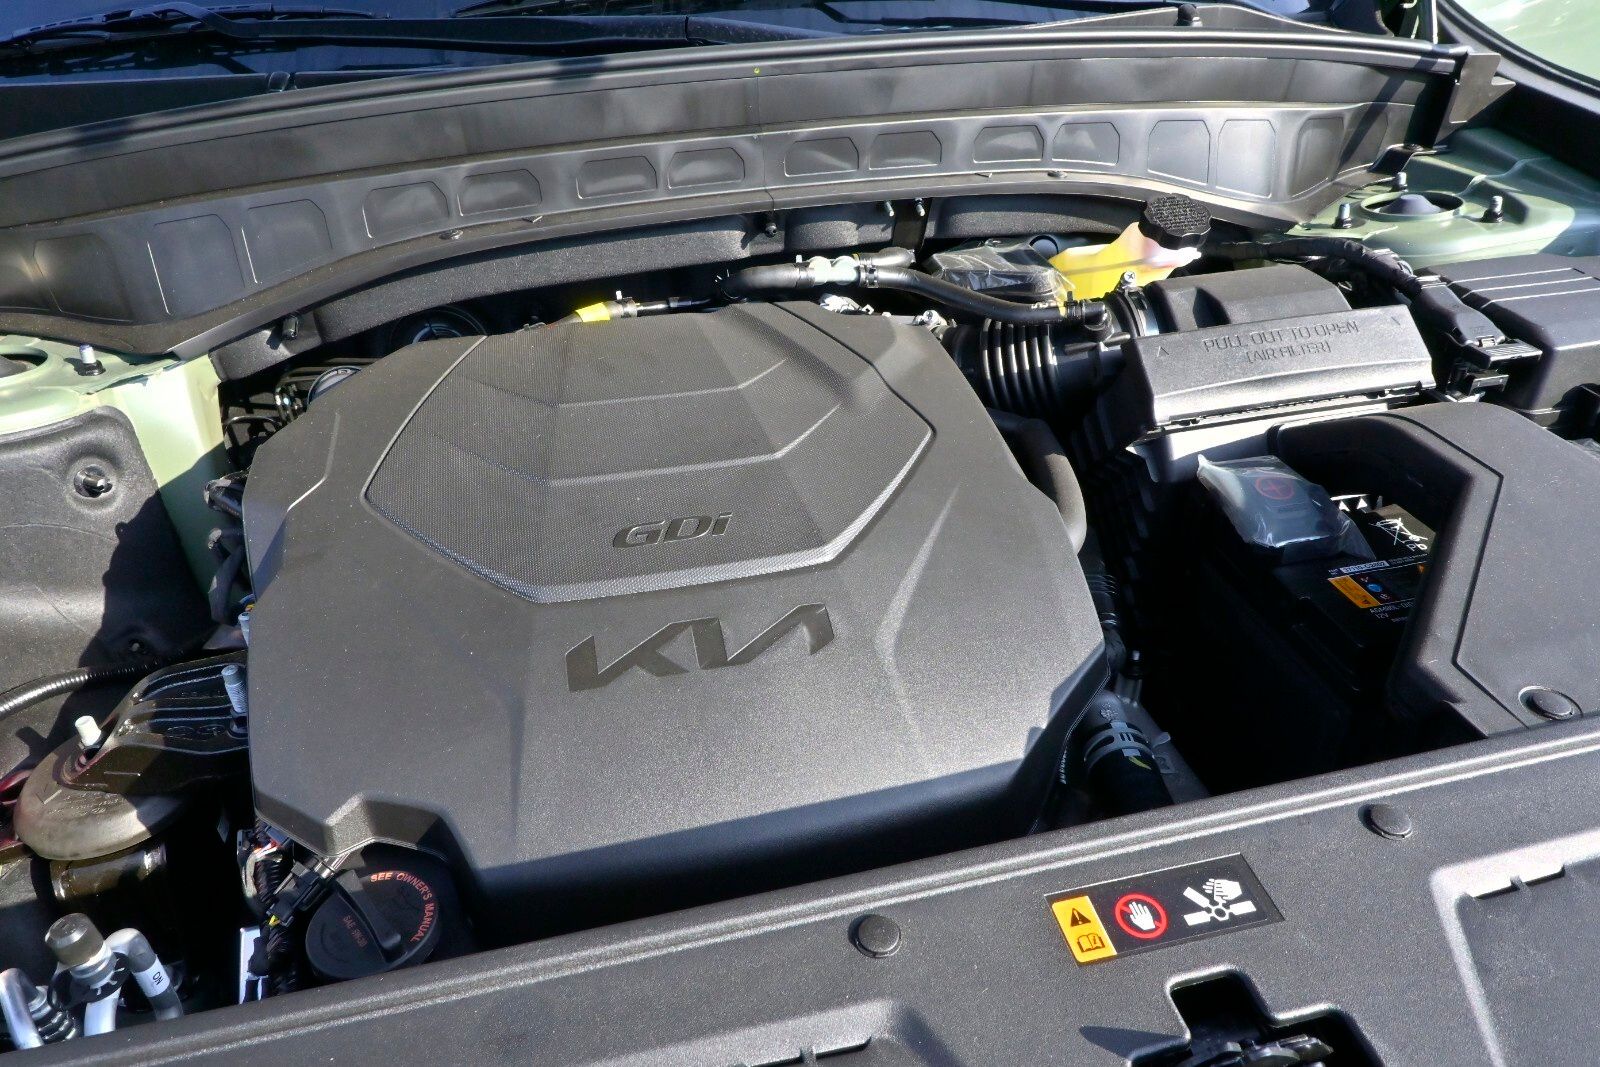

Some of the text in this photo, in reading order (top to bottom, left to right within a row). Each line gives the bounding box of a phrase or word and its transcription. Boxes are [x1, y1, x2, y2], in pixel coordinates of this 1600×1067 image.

[1202, 321, 1359, 352] PULL OUT TO OPEN
[612, 511, 733, 548] GDi
[565, 602, 835, 692] KIA
[370, 872, 435, 943] SEE OWNER'S MANUAL
